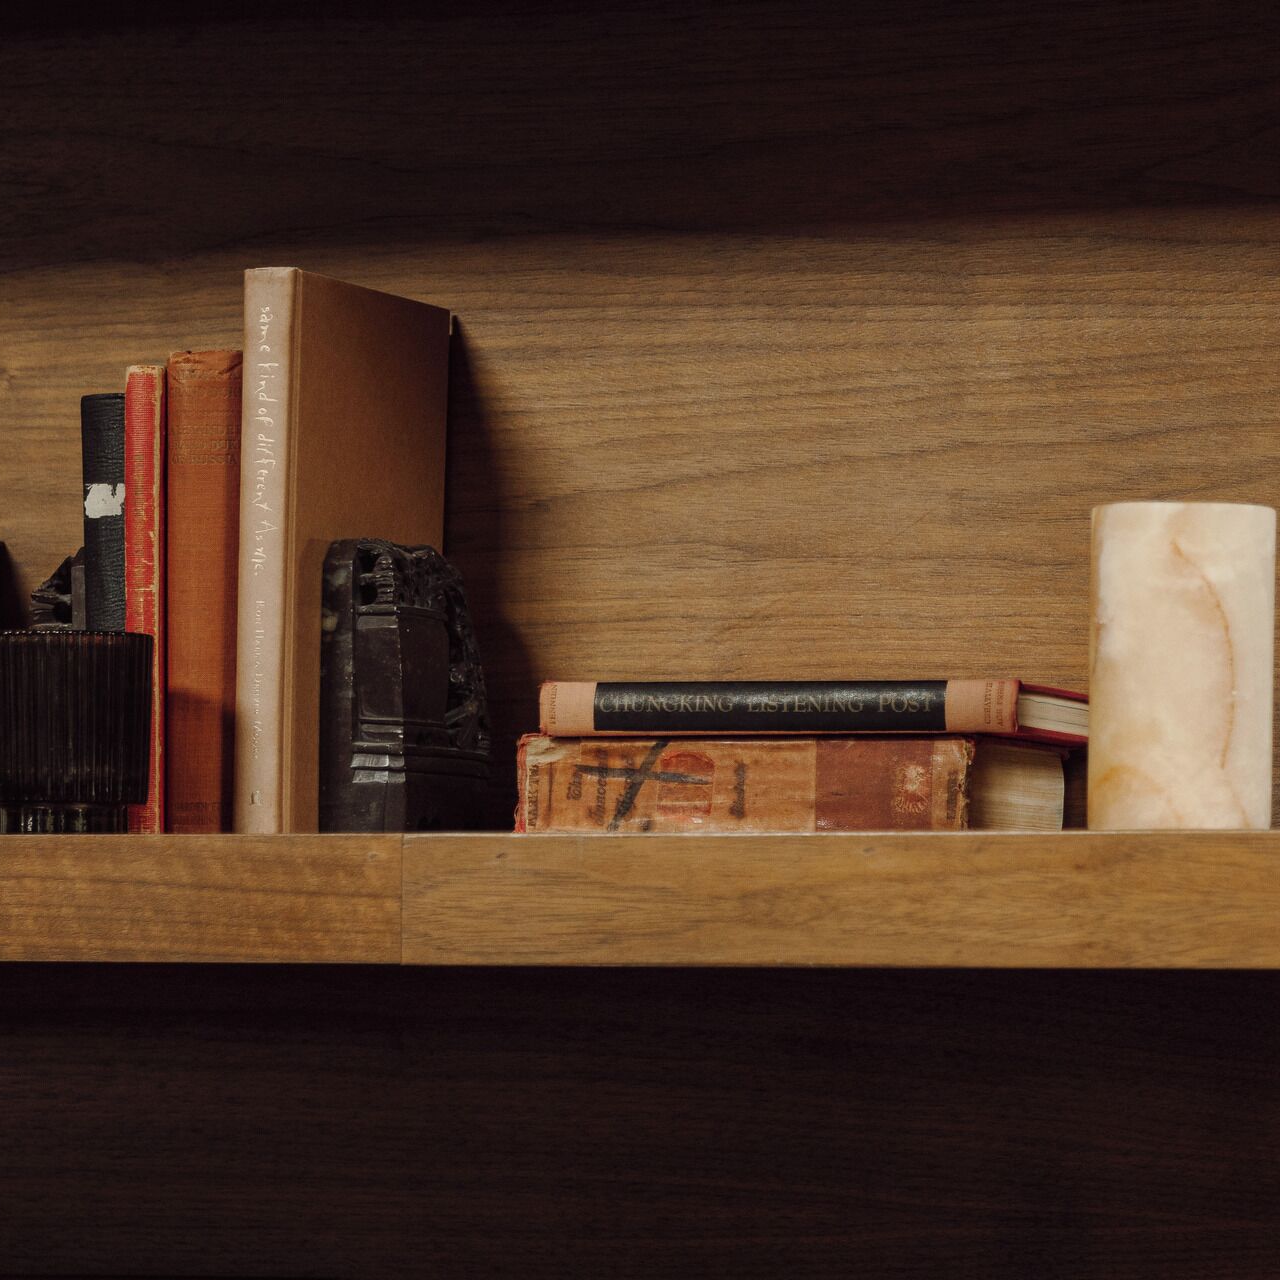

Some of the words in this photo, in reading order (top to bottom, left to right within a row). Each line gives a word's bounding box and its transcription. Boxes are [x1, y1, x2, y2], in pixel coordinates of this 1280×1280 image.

[254, 361, 280, 403] kind
[255, 406, 274, 428] of
[250, 432, 277, 513] different
[599, 695, 734, 714] CHUNGKING
[746, 694, 865, 714] LISTENING
[877, 694, 933, 713] POST
